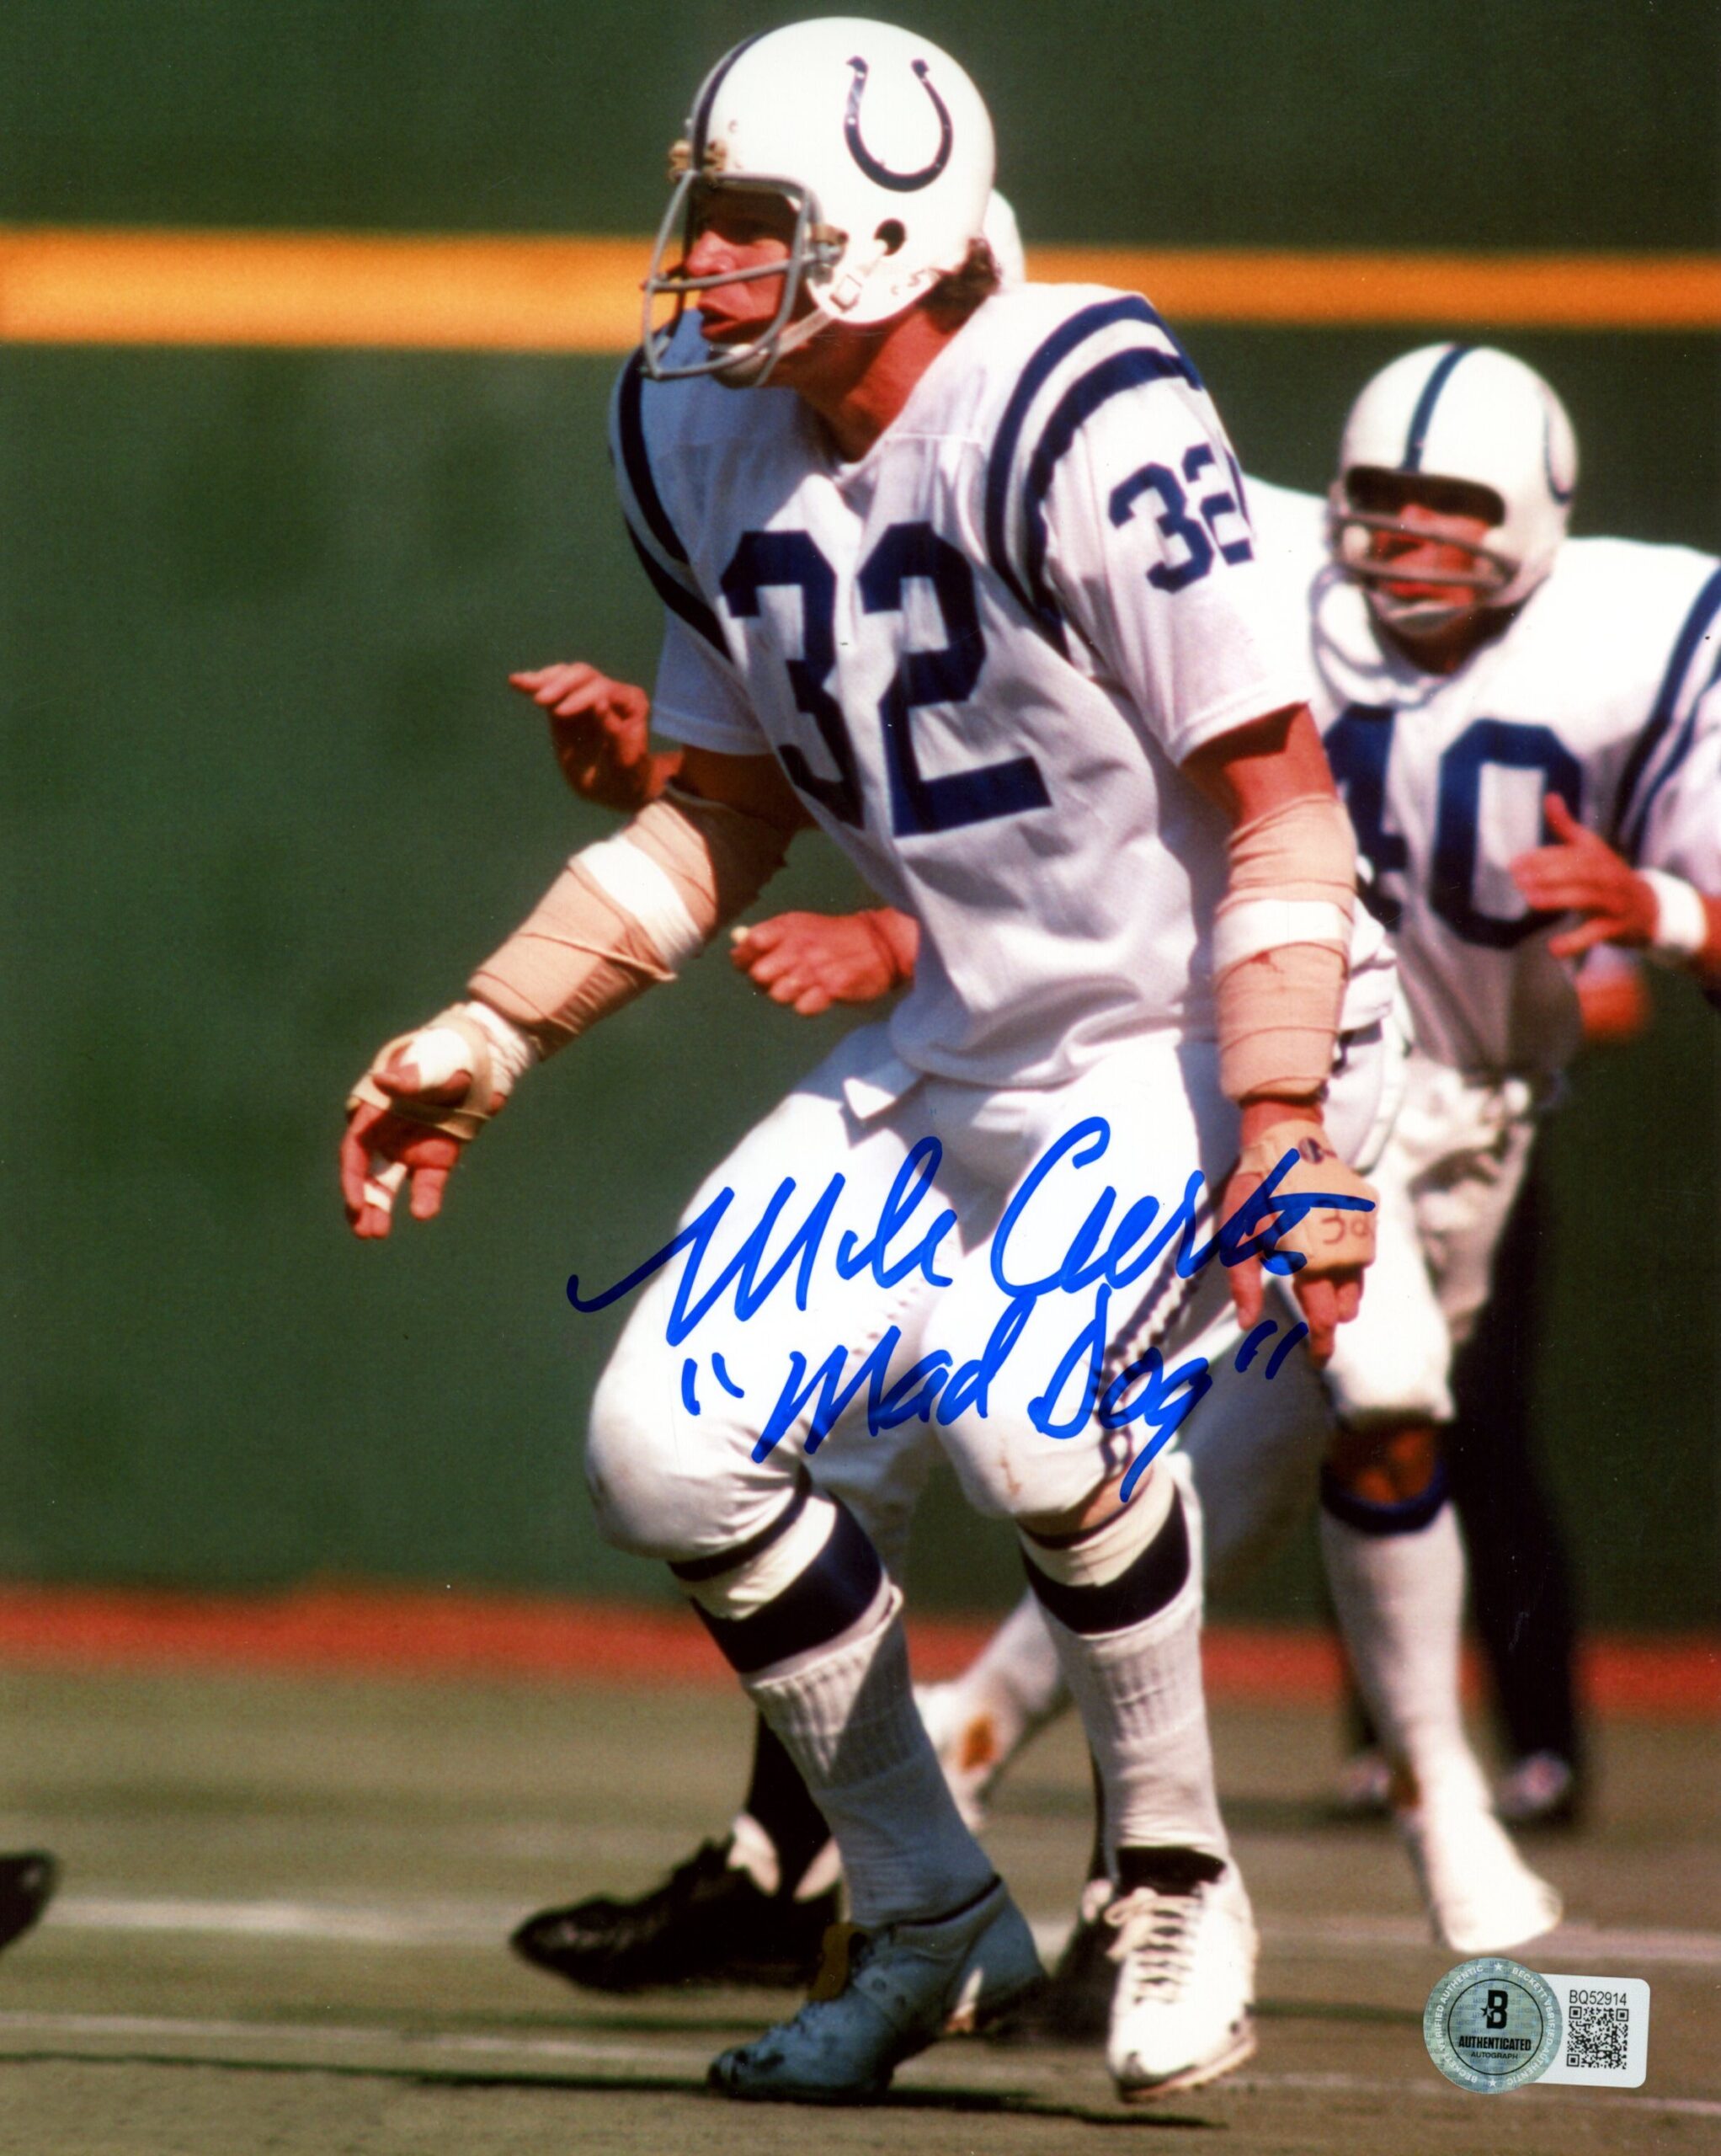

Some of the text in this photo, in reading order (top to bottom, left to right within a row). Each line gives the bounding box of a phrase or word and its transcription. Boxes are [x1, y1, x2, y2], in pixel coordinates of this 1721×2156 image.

[1109, 442, 1255, 594] 32
[720, 521, 1052, 838] 32
[1440, 1965, 1484, 2004] AUTHENTIC
[1512, 1967, 1548, 1998] BECKETT
[1569, 1989, 1627, 2005] BQ52914
[1486, 1989, 1508, 2029] B
[1458, 2036, 1532, 2051] AUTHENTICATED
[1470, 2051, 1519, 2060] AUTOGRAPH
[1442, 2052, 1478, 2084] BECKETT
[1506, 2047, 1550, 2086] AUTHENTIC
